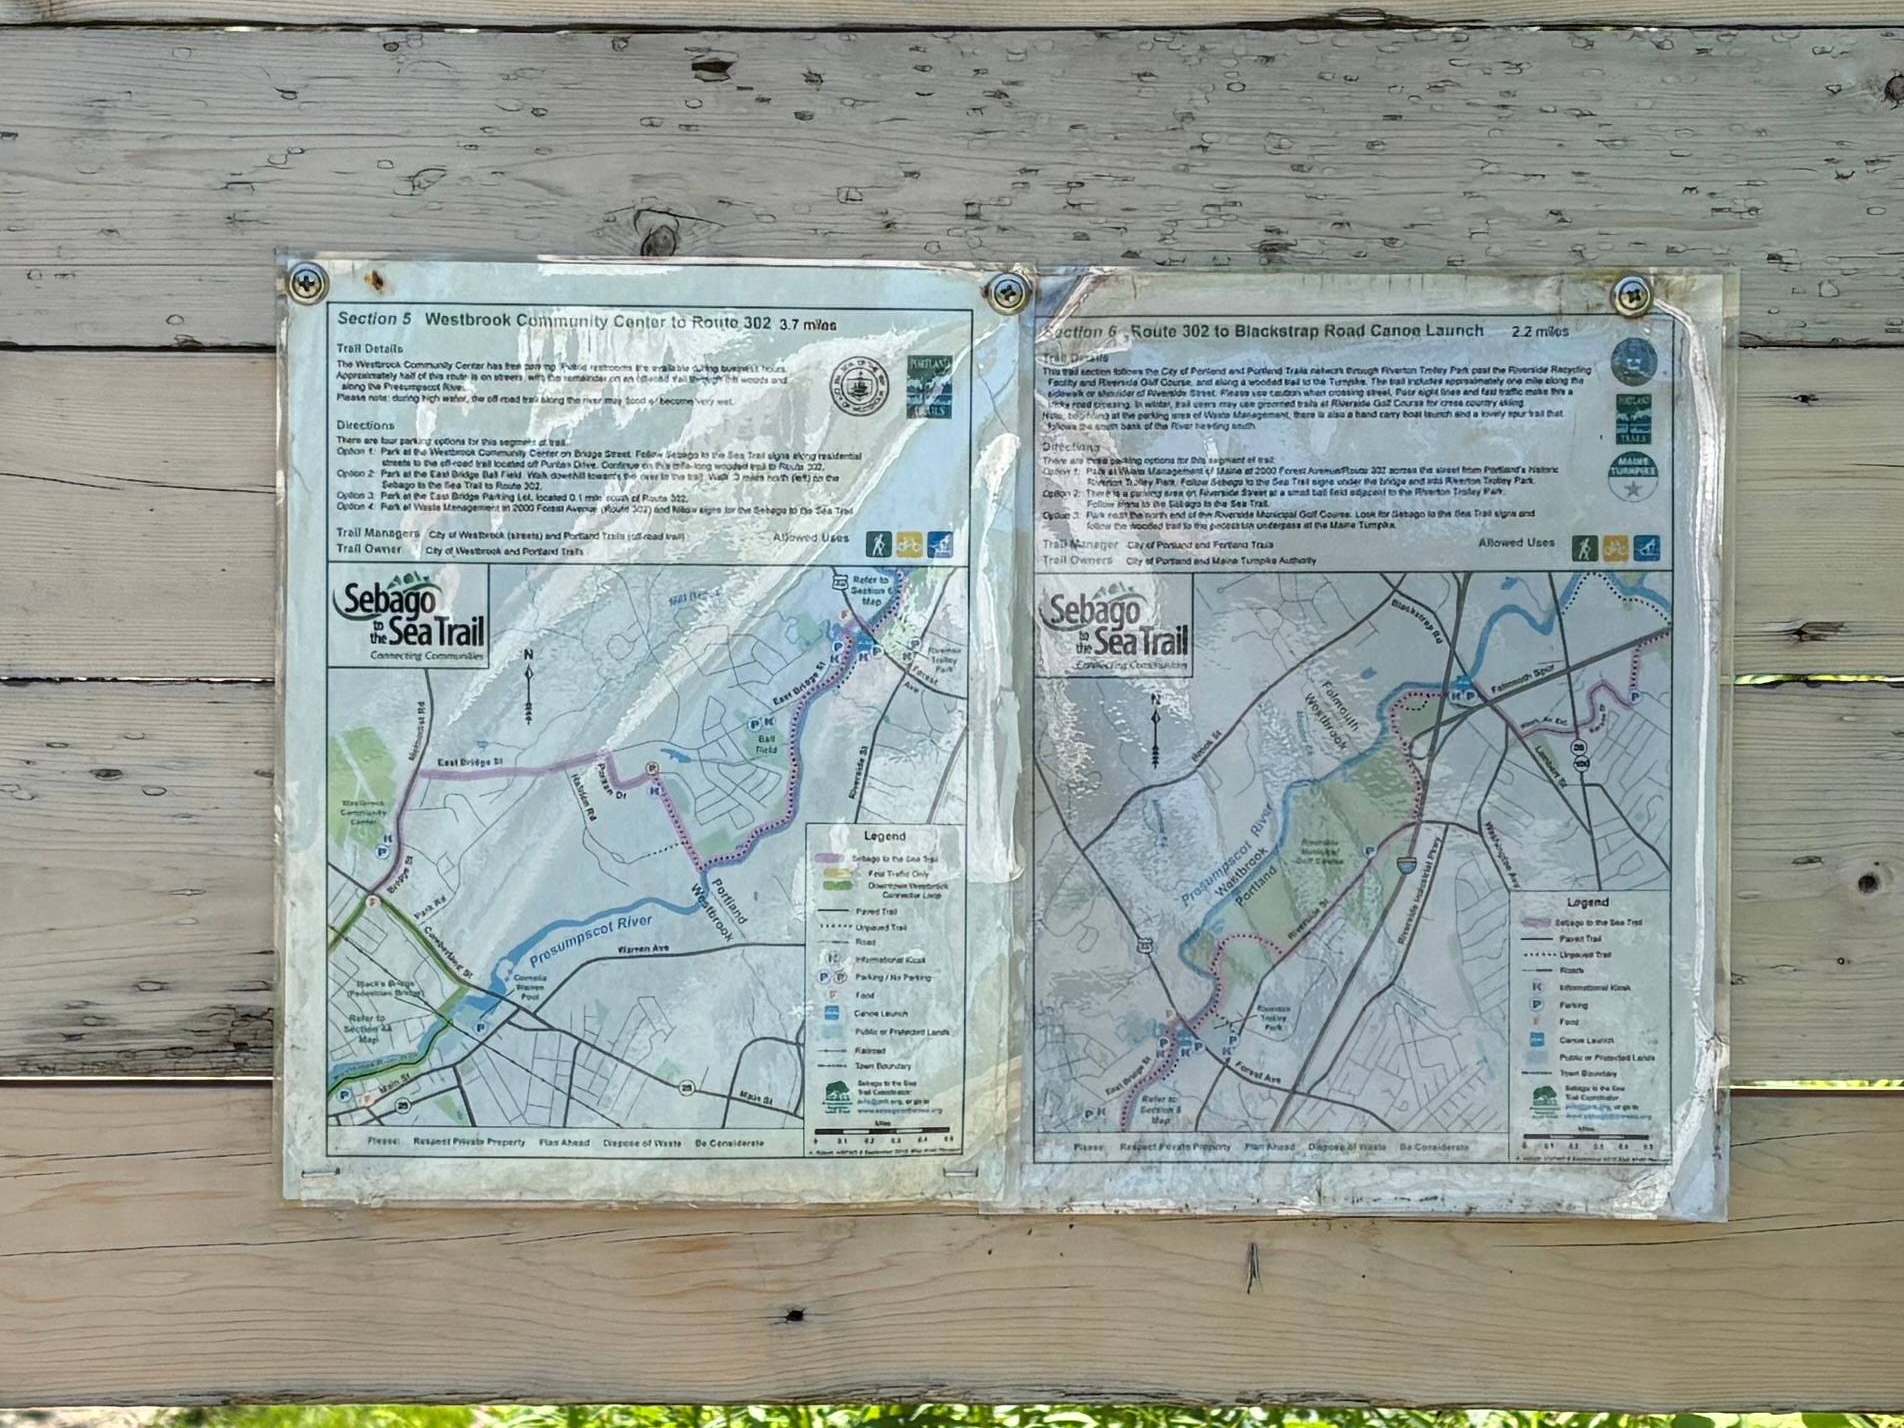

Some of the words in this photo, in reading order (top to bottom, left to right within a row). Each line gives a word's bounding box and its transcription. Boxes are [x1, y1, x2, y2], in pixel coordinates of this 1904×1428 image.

[337, 312, 396, 325] Section
[402, 312, 412, 325] 5
[425, 313, 511, 327] Westbrook
[517, 314, 607, 330] Community
[671, 316, 687, 329] to
[692, 315, 739, 329] Route
[743, 316, 772, 330] 302
[779, 319, 800, 331] 3.7
[803, 319, 837, 331] miles
[1107, 325, 1117, 338] 6
[1132, 324, 1177, 339] Route
[1182, 324, 1210, 339] 302
[1215, 325, 1230, 339] to
[1234, 324, 1319, 342] Blackstrap
[1324, 324, 1366, 338] Road
[1370, 324, 1421, 338] Canoe
[1425, 324, 1484, 338] Launch
[1512, 326, 1532, 338] 2.2
[1536, 326, 1570, 338] miles
[337, 421, 395, 431] Directions
[336, 527, 361, 538] Trail
[1478, 538, 1524, 548] Allowed
[1527, 538, 1556, 548] Uses
[336, 544, 361, 554] Trail
[345, 582, 437, 623] Sebago
[1050, 593, 1141, 632] Sebago
[370, 632, 387, 645] the
[389, 616, 433, 646] Sea
[435, 615, 484, 647] Trail
[1094, 626, 1137, 655] Sea
[1139, 624, 1189, 656] Trail
[1304, 691, 1347, 750] Westbrook
[1321, 680, 1359, 732] Falmouth
[864, 830, 906, 842] Legend
[1250, 803, 1274, 838] River
[711, 878, 749, 925] Portland
[1235, 865, 1278, 908] Portland
[691, 883, 734, 942] Westbrook
[1567, 897, 1610, 910] Legend
[617, 915, 653, 930] River
